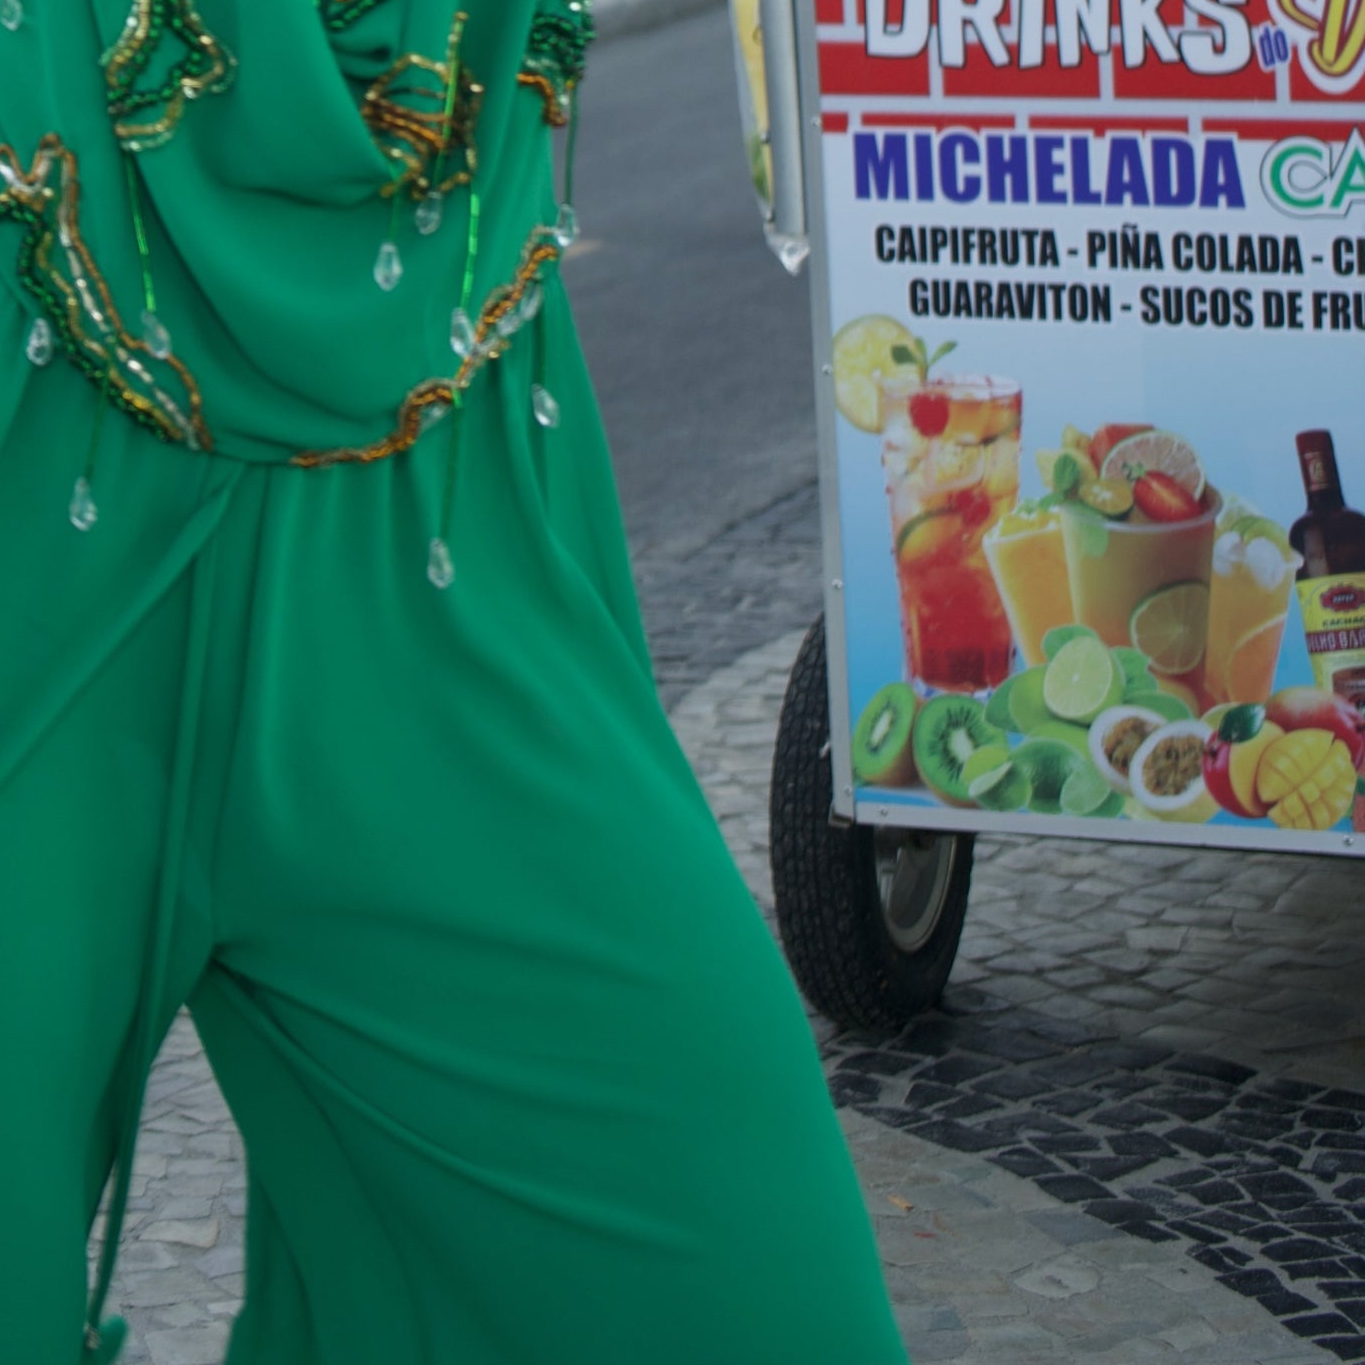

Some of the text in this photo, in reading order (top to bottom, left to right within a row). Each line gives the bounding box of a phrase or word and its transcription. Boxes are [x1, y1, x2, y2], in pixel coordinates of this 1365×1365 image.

[1259, 25, 1289, 68] do
[852, 132, 1246, 210] MICHELADA
[875, 225, 1060, 267] CAIPIFRUTA
[1086, 224, 1165, 271] PIÑA
[1171, 232, 1304, 275] COLADA
[908, 278, 1112, 323] GUARAVITON
[1139, 285, 1254, 328] SUCOS
[1262, 290, 1304, 330] DE
